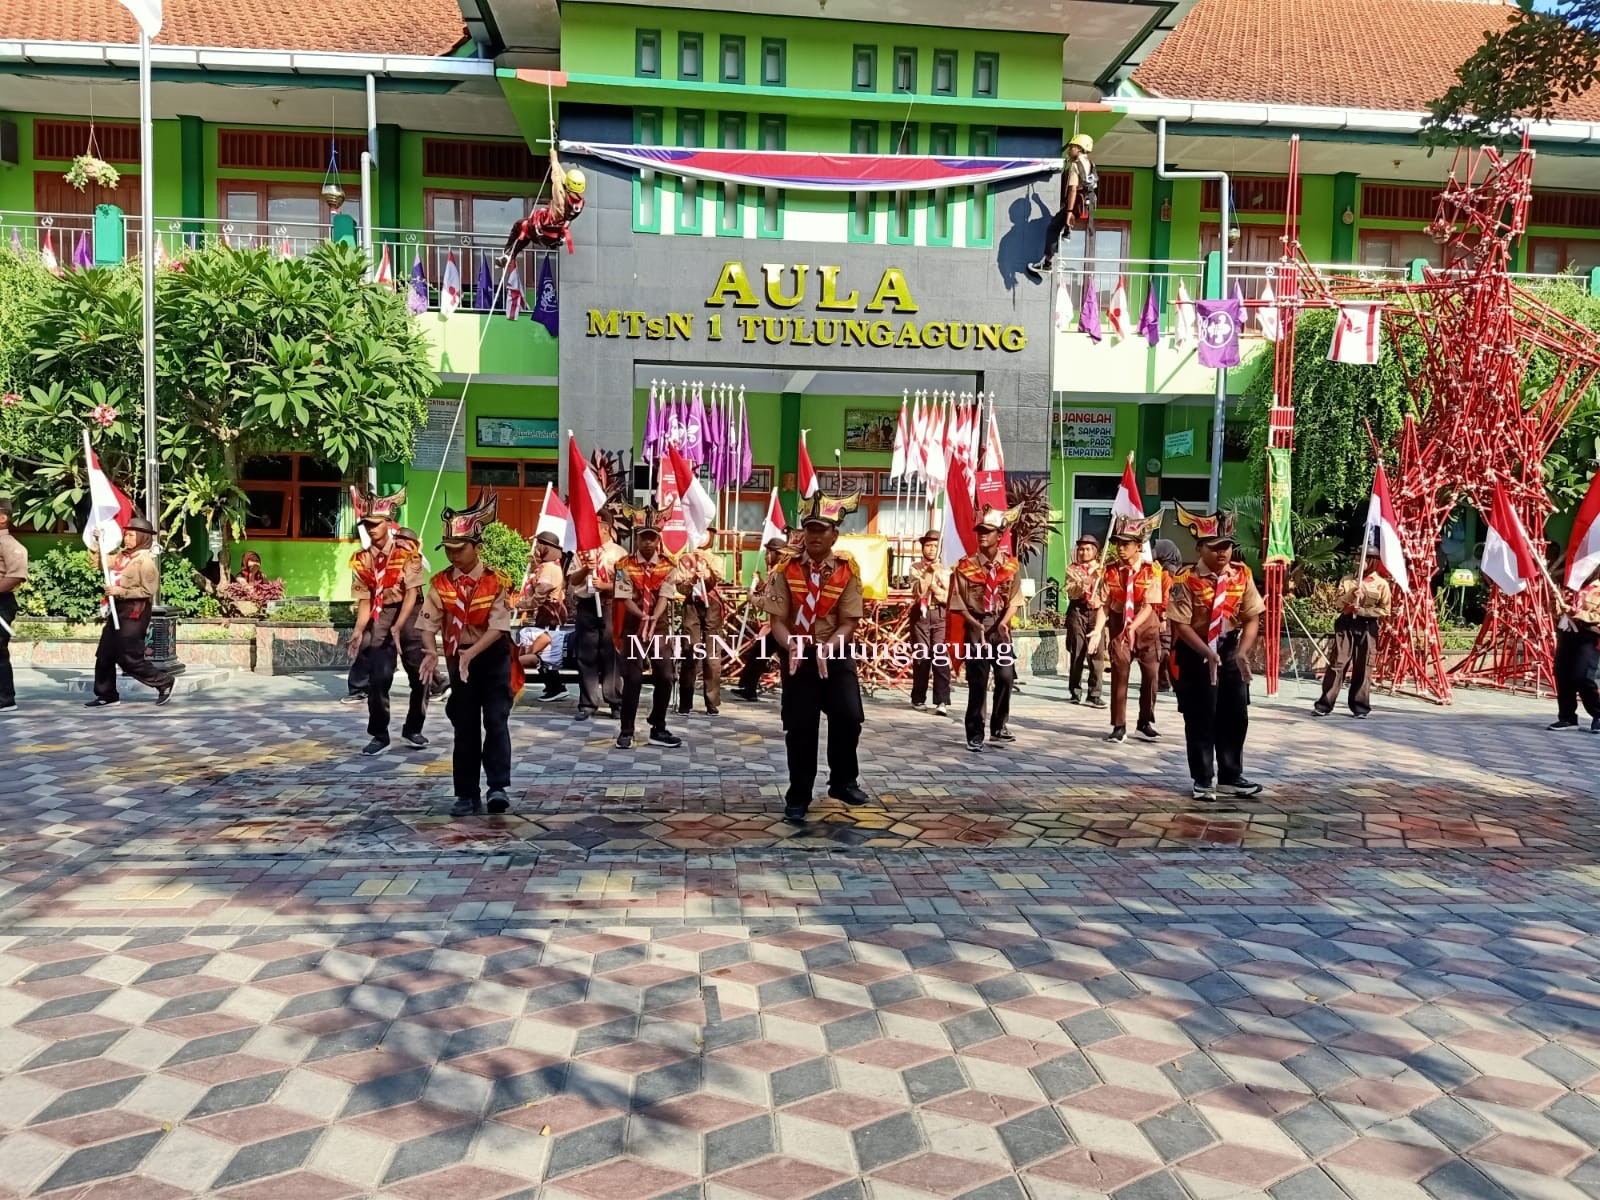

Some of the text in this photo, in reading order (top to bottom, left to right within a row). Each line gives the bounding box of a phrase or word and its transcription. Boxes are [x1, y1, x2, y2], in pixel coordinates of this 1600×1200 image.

[705, 261, 920, 313] AULA
[586, 309, 1028, 352] MTsN 1 TULUNGAGUNG
[1078, 426, 1111, 436] SAMPAH
[1090, 438, 1111, 446] PADA
[1064, 447, 1111, 457] TEMPATNYA
